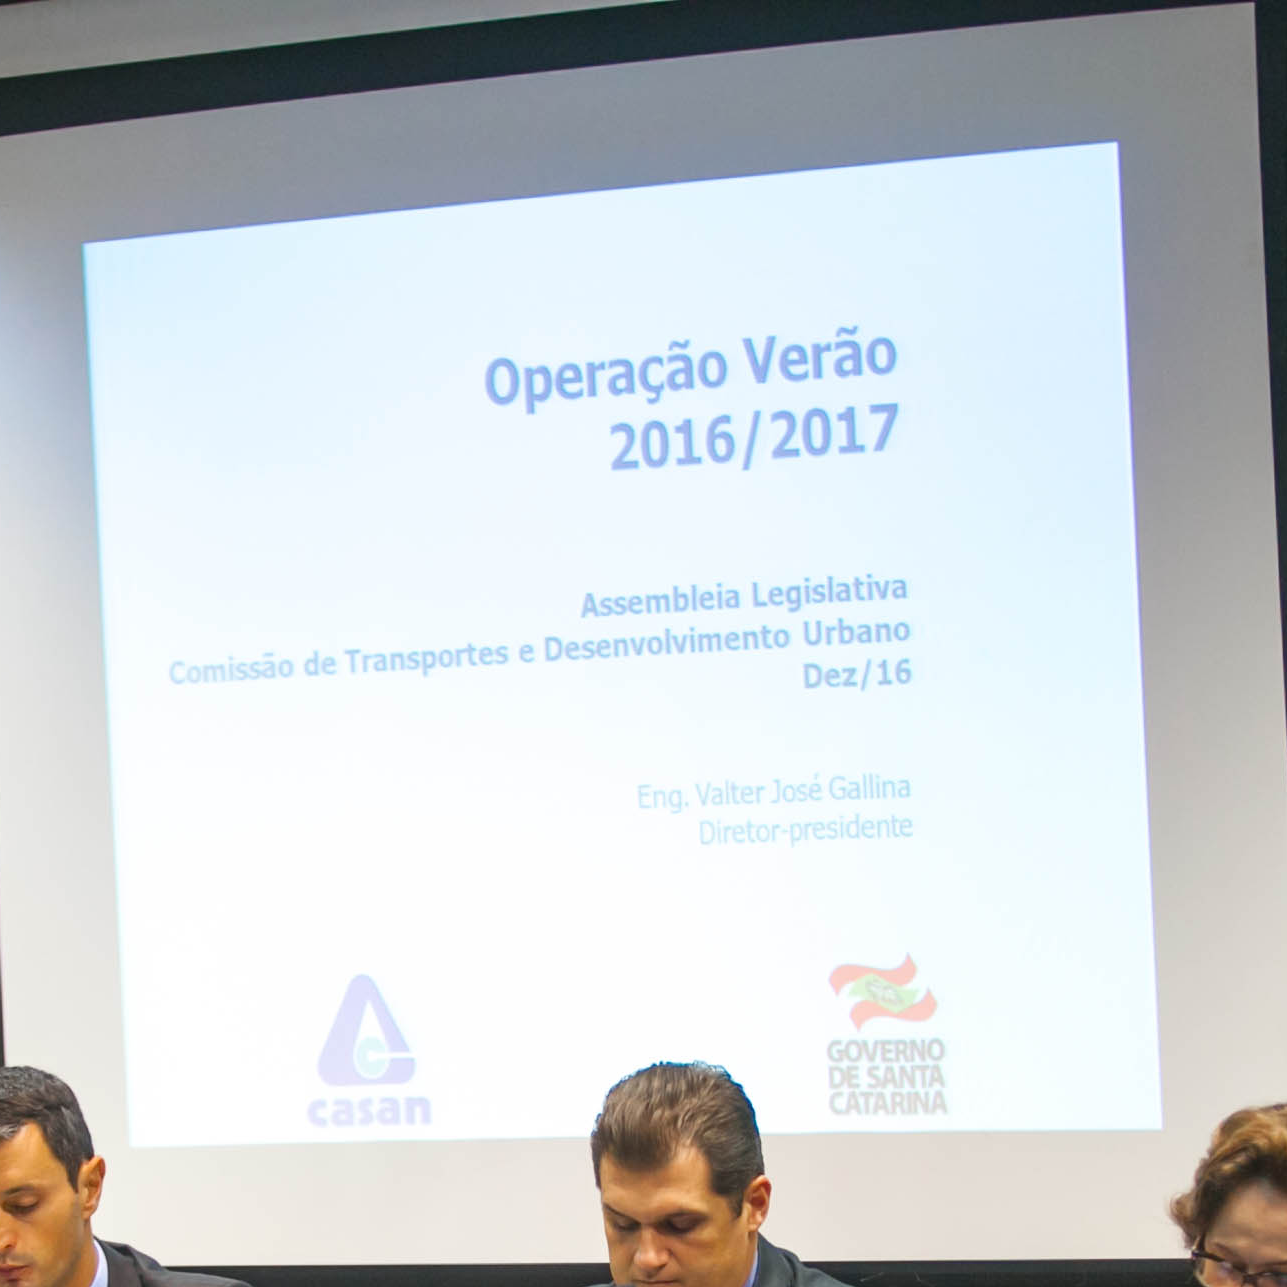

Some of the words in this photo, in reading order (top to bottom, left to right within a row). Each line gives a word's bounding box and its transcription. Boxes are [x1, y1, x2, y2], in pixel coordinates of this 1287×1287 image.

[485, 340, 728, 414] Operação
[743, 326, 898, 384] Verão
[610, 402, 900, 471] 2016/2017
[581, 583, 741, 618] Assembleia
[752, 574, 908, 613] Legislativa
[169, 652, 295, 685] Comissão
[304, 650, 337, 676] de
[344, 643, 510, 677] Transportes
[519, 644, 535, 663] e
[545, 624, 792, 662] Desenvolvimento
[803, 617, 912, 646] Urbano
[803, 657, 913, 691] Dez/16
[637, 784, 689, 814] Eng.
[695, 780, 765, 807] Valter
[771, 772, 822, 804] José
[829, 774, 911, 800] Gallina
[699, 813, 913, 847] Diretor-presidente
[827, 1038, 946, 1063] GOVERNO
[828, 1065, 860, 1089] DE
[866, 1063, 946, 1089] SANTA
[308, 1096, 432, 1127] casan
[829, 1090, 949, 1115] CATARINA
